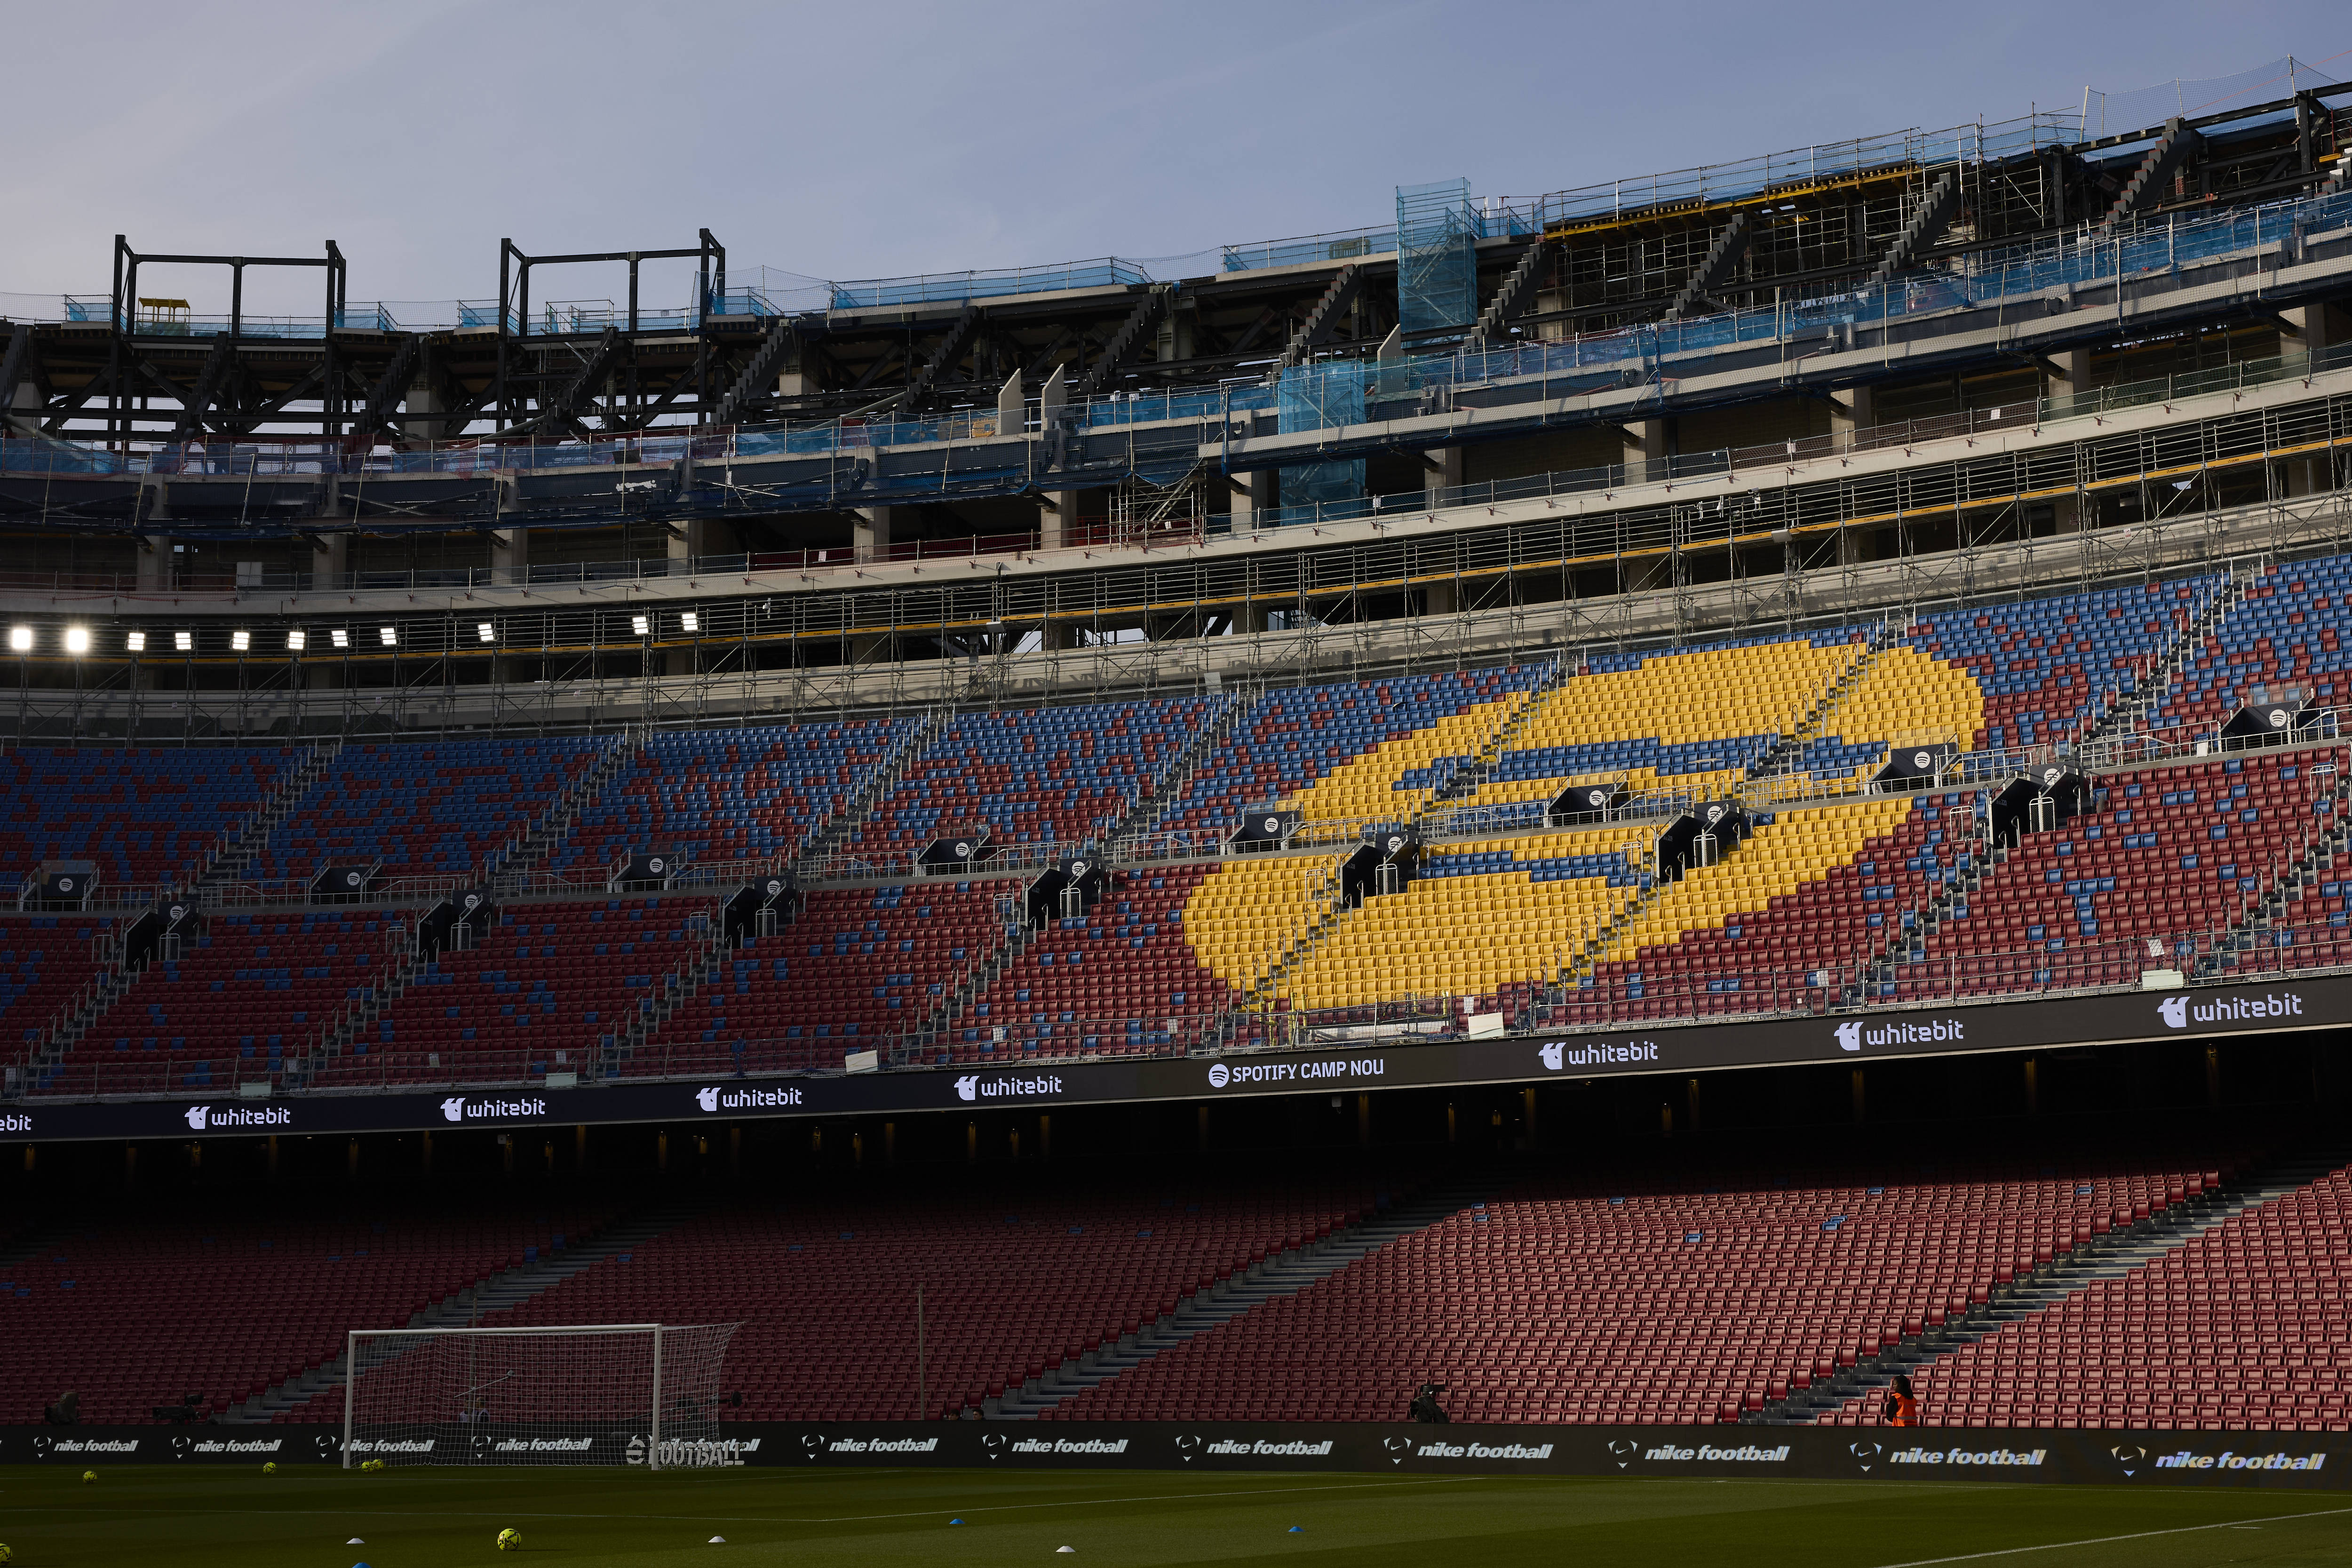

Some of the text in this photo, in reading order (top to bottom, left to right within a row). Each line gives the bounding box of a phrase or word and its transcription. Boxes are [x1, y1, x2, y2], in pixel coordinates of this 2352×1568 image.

[2194, 993, 2303, 1022] whitebit
[1867, 1019, 1964, 1045] whitebit
[1569, 1041, 1658, 1065] whitebit
[1233, 1059, 1383, 1082] SPOTIFY CAMP NOU
[982, 1075, 1062, 1096] whitebit
[723, 1088, 802, 1107] whitebit
[468, 1098, 546, 1117] whitebit
[212, 1107, 291, 1126] whitebit
[54, 1440, 139, 1452] nike football
[194, 1440, 282, 1452] nike football
[374, 1440, 435, 1452] football
[495, 1438, 593, 1451] nike football
[829, 1438, 938, 1452] nike football
[1012, 1438, 1129, 1453] nike football
[1207, 1440, 1333, 1455] nike football
[1418, 1442, 1554, 1459] nike football
[1645, 1444, 1790, 1461] nike football
[1890, 1448, 2047, 1465] nike football
[2156, 1451, 2326, 1470] nike football
